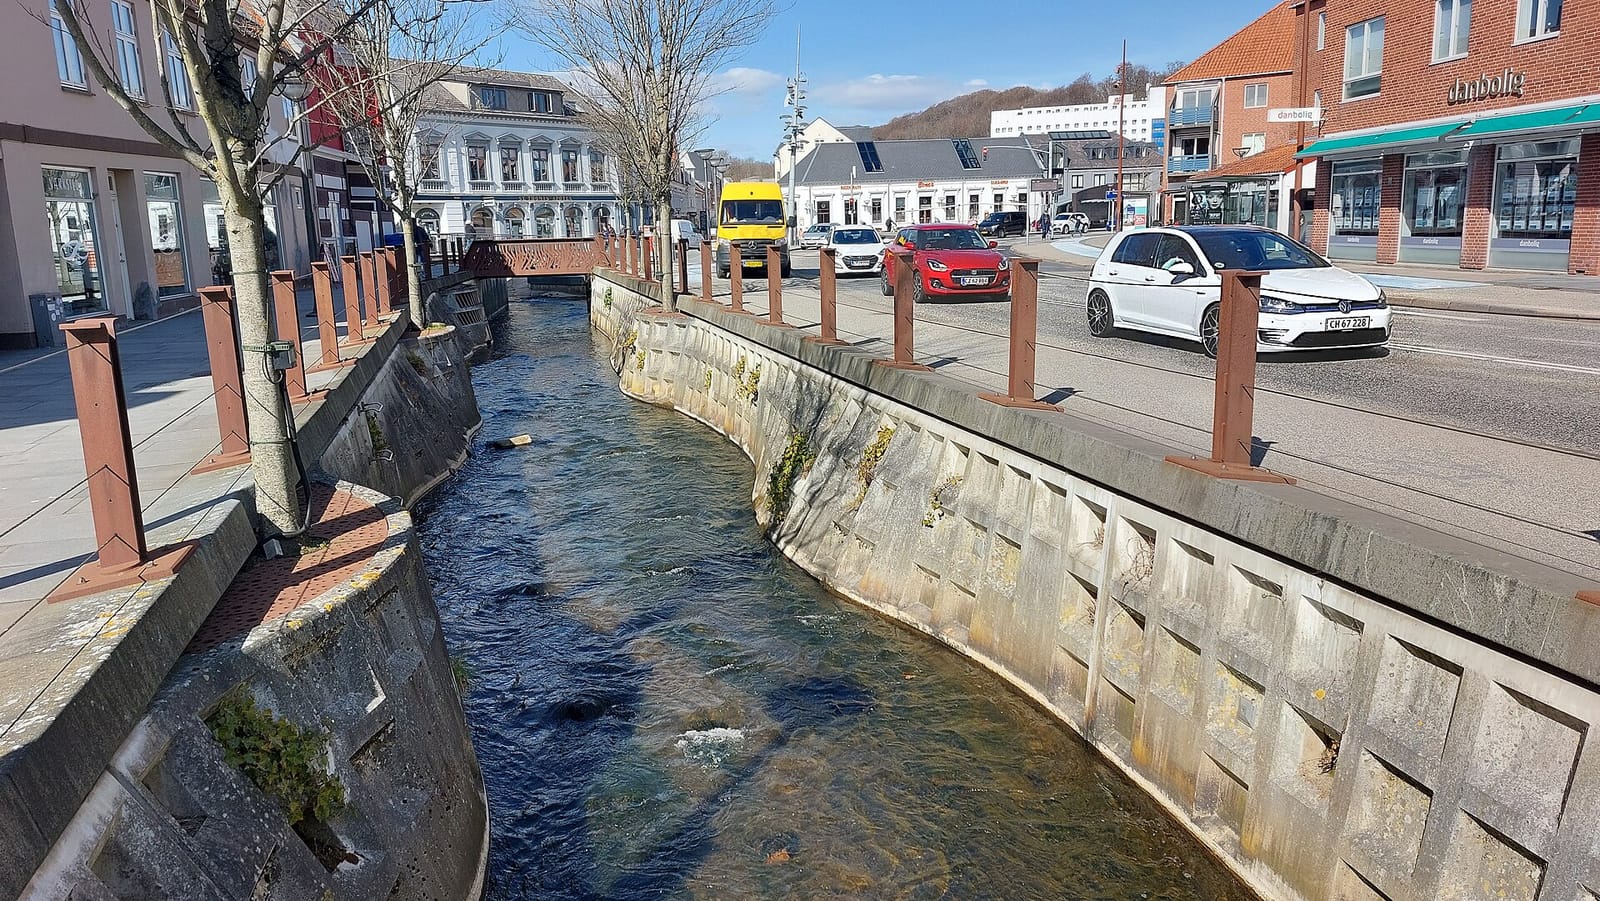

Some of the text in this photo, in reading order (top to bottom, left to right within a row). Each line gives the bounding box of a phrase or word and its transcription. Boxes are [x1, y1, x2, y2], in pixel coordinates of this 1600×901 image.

[1448, 67, 1525, 104] danbolig
[1277, 111, 1313, 119] danbolig
[1329, 318, 1367, 329] CH 67 228
